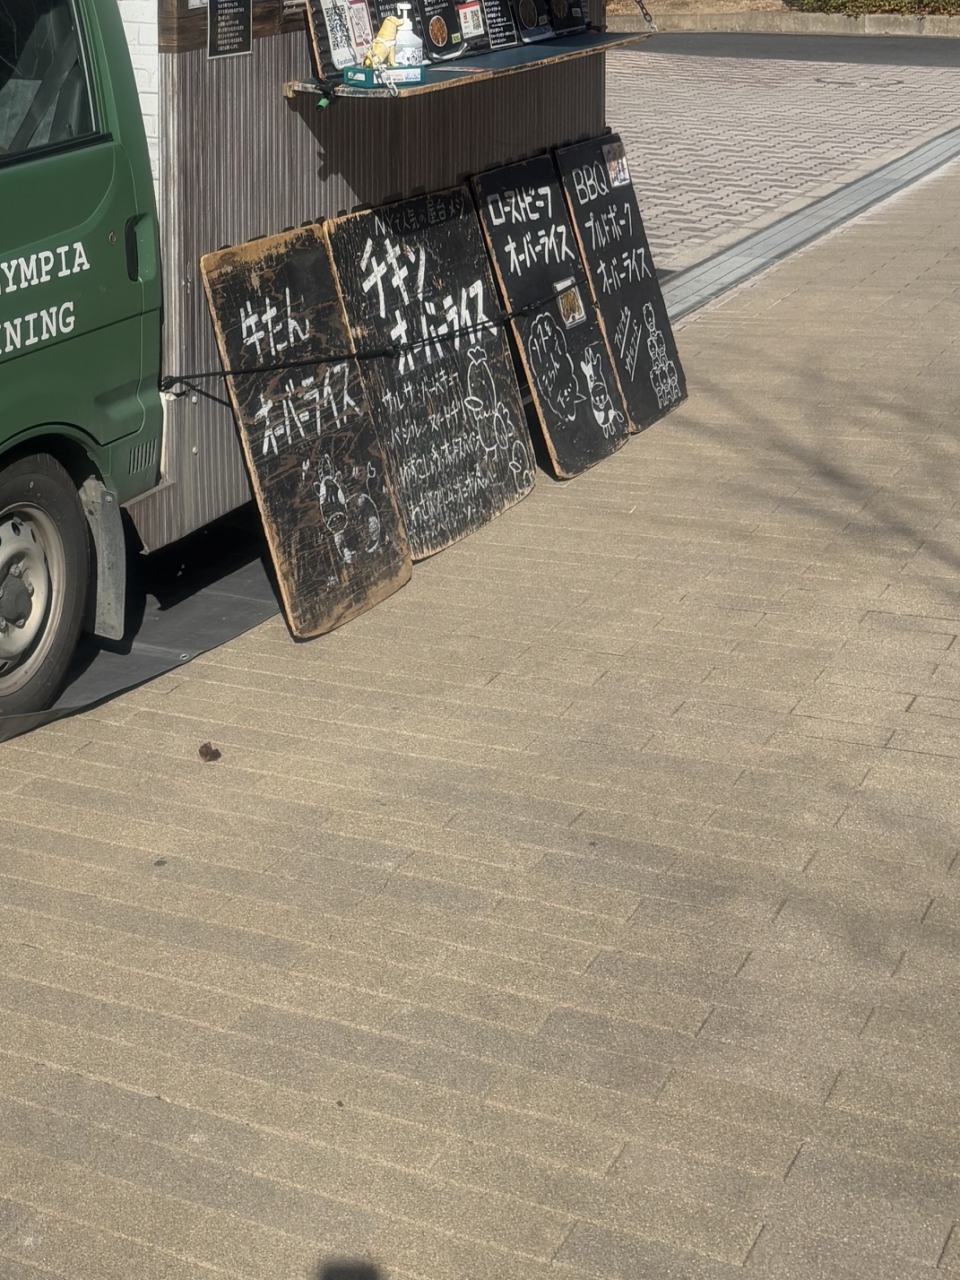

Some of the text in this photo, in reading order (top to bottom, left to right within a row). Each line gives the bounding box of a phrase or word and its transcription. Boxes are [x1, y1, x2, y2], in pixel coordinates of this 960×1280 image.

[486, 186, 552, 226] ローストビーフ
[572, 160, 609, 205] BBQ
[504, 224, 576, 276] オーバーライス
[584, 202, 633, 251] プルドポーク
[360, 237, 426, 319] チキン
[596, 247, 652, 295] オーバーライス
[240, 287, 310, 363] 牛たん
[390, 279, 498, 375] オーバーライス
[254, 362, 364, 456] オーバーライス
